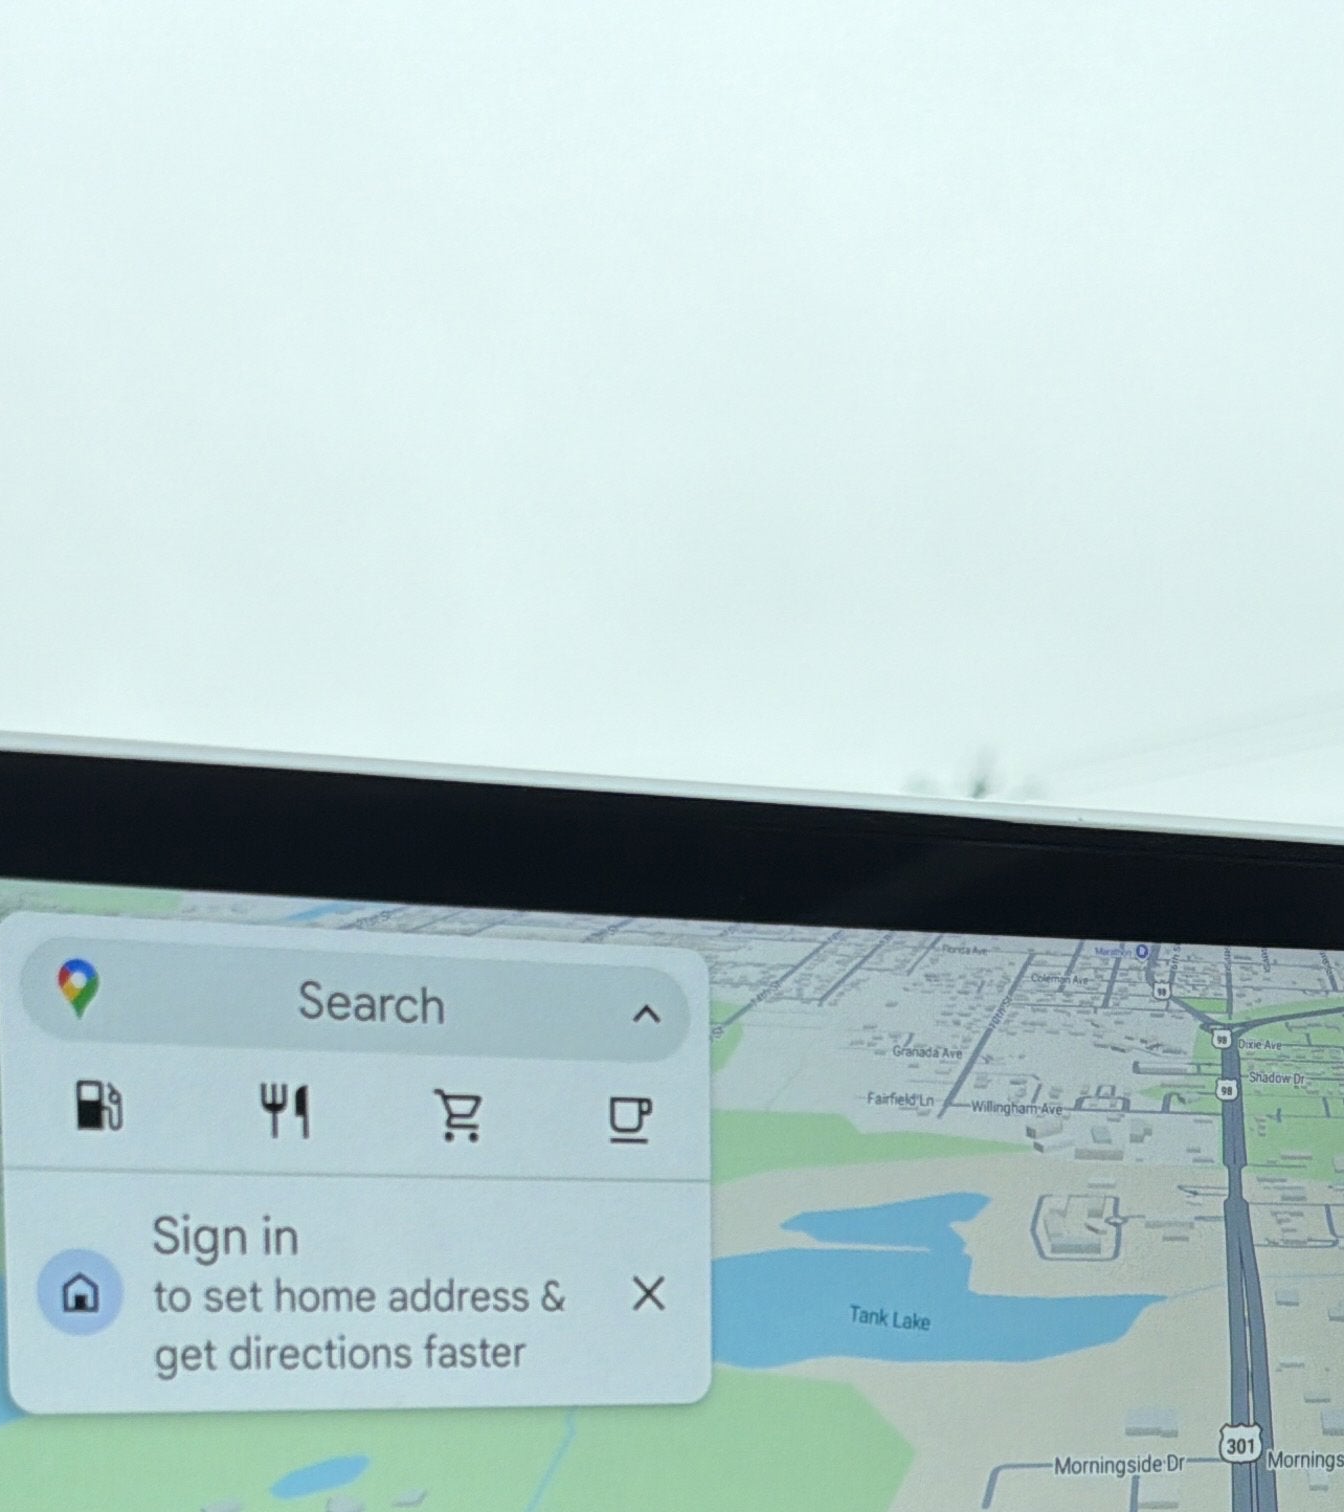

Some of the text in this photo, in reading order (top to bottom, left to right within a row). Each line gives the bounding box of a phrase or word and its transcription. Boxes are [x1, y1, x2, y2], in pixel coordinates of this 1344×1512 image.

[1031, 972, 1089, 985] Coleman Ave
[299, 979, 445, 1024] Search
[1217, 1035, 1228, 1045] 98
[1238, 1038, 1282, 1051] Dixie Ave
[893, 1045, 963, 1060] Granada Ave
[1249, 1071, 1305, 1085] Shadow Dr
[867, 1091, 935, 1107] Fairfield Ln
[1221, 1086, 1233, 1096] 98
[971, 1101, 1063, 1117] Willingham Ave
[153, 1213, 299, 1266] Sign in
[154, 1277, 566, 1313] to set home address &
[850, 1304, 932, 1331] Tank Lake
[155, 1333, 527, 1381] get directions faster
[1226, 1438, 1255, 1454] 301
[1055, 1455, 1185, 1477] Morningside Dr
